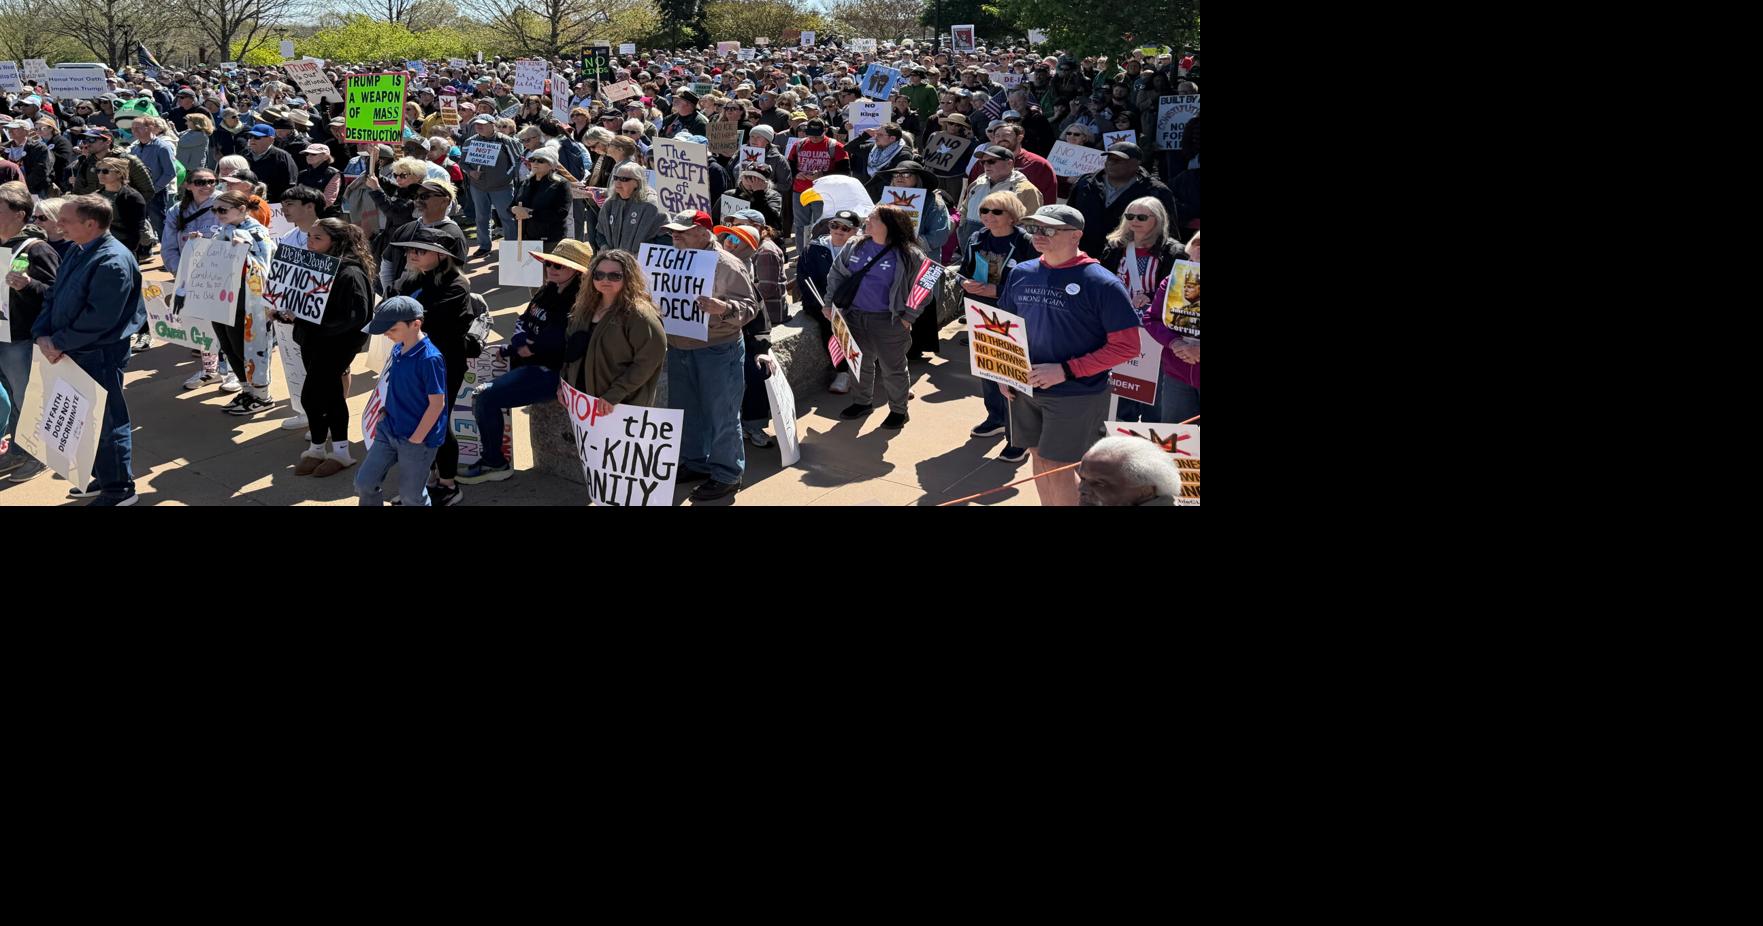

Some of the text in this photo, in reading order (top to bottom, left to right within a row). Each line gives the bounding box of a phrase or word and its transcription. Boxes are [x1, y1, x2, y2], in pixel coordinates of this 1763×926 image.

[584, 56, 605, 68] NO
[348, 75, 401, 87] TRUMP IS
[553, 77, 565, 94] NO
[349, 91, 401, 103] A WEAPON
[1161, 96, 1185, 105] BUILT
[349, 107, 399, 119] OF MASS
[1171, 123, 1185, 131] NO
[937, 137, 961, 149] NO
[1056, 146, 1074, 157] NO
[661, 144, 691, 161] The
[924, 149, 953, 167] WAR
[657, 157, 708, 184] GRIFT
[676, 182, 688, 195] of
[281, 245, 294, 260] We
[304, 252, 333, 271] People
[646, 247, 698, 270] FIGHT
[268, 261, 310, 290] SAY NO
[652, 272, 704, 295] TRUTH
[142, 284, 161, 302] NO
[1043, 296, 1066, 307] AGAIN
[280, 287, 324, 319] KINGS
[165, 313, 182, 324] the
[975, 331, 1025, 357] NO THRONES
[976, 344, 1027, 369] NO CROWNS
[978, 356, 1028, 384] NO KINGS
[1111, 379, 1140, 391] IDENT
[44, 393, 63, 432] MY FAITH
[52, 396, 71, 438] DOES NOT
[58, 394, 79, 452] DISCRIMINATE
[623, 410, 673, 440] the
